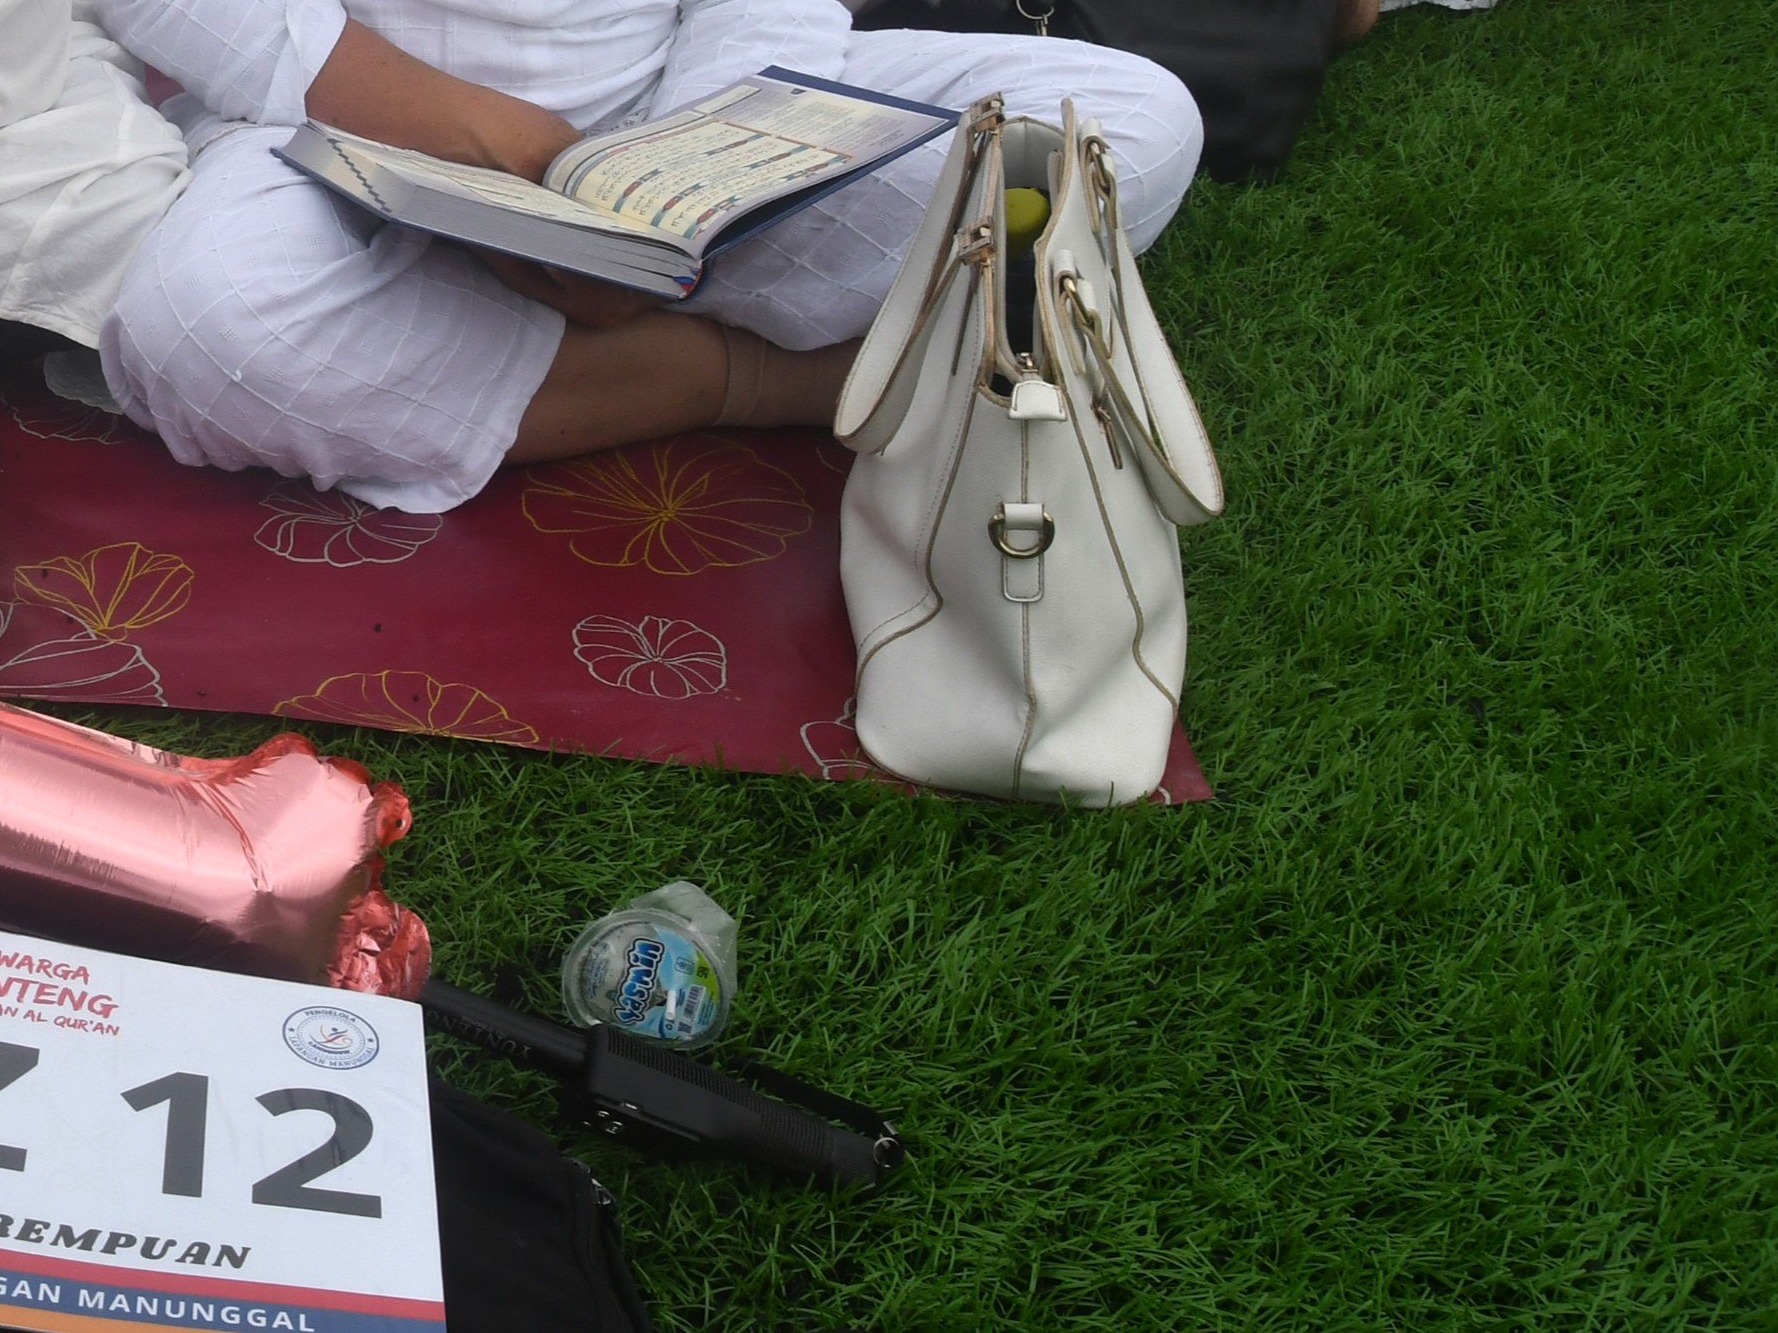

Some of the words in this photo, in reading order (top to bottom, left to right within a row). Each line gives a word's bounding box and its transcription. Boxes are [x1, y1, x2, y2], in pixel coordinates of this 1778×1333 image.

[23, 1009, 48, 1023] AL
[53, 1015, 120, 1036] QUR'AN
[120, 1071, 383, 1219] 12
[77, 1287, 317, 1333] MANUNGGAL
